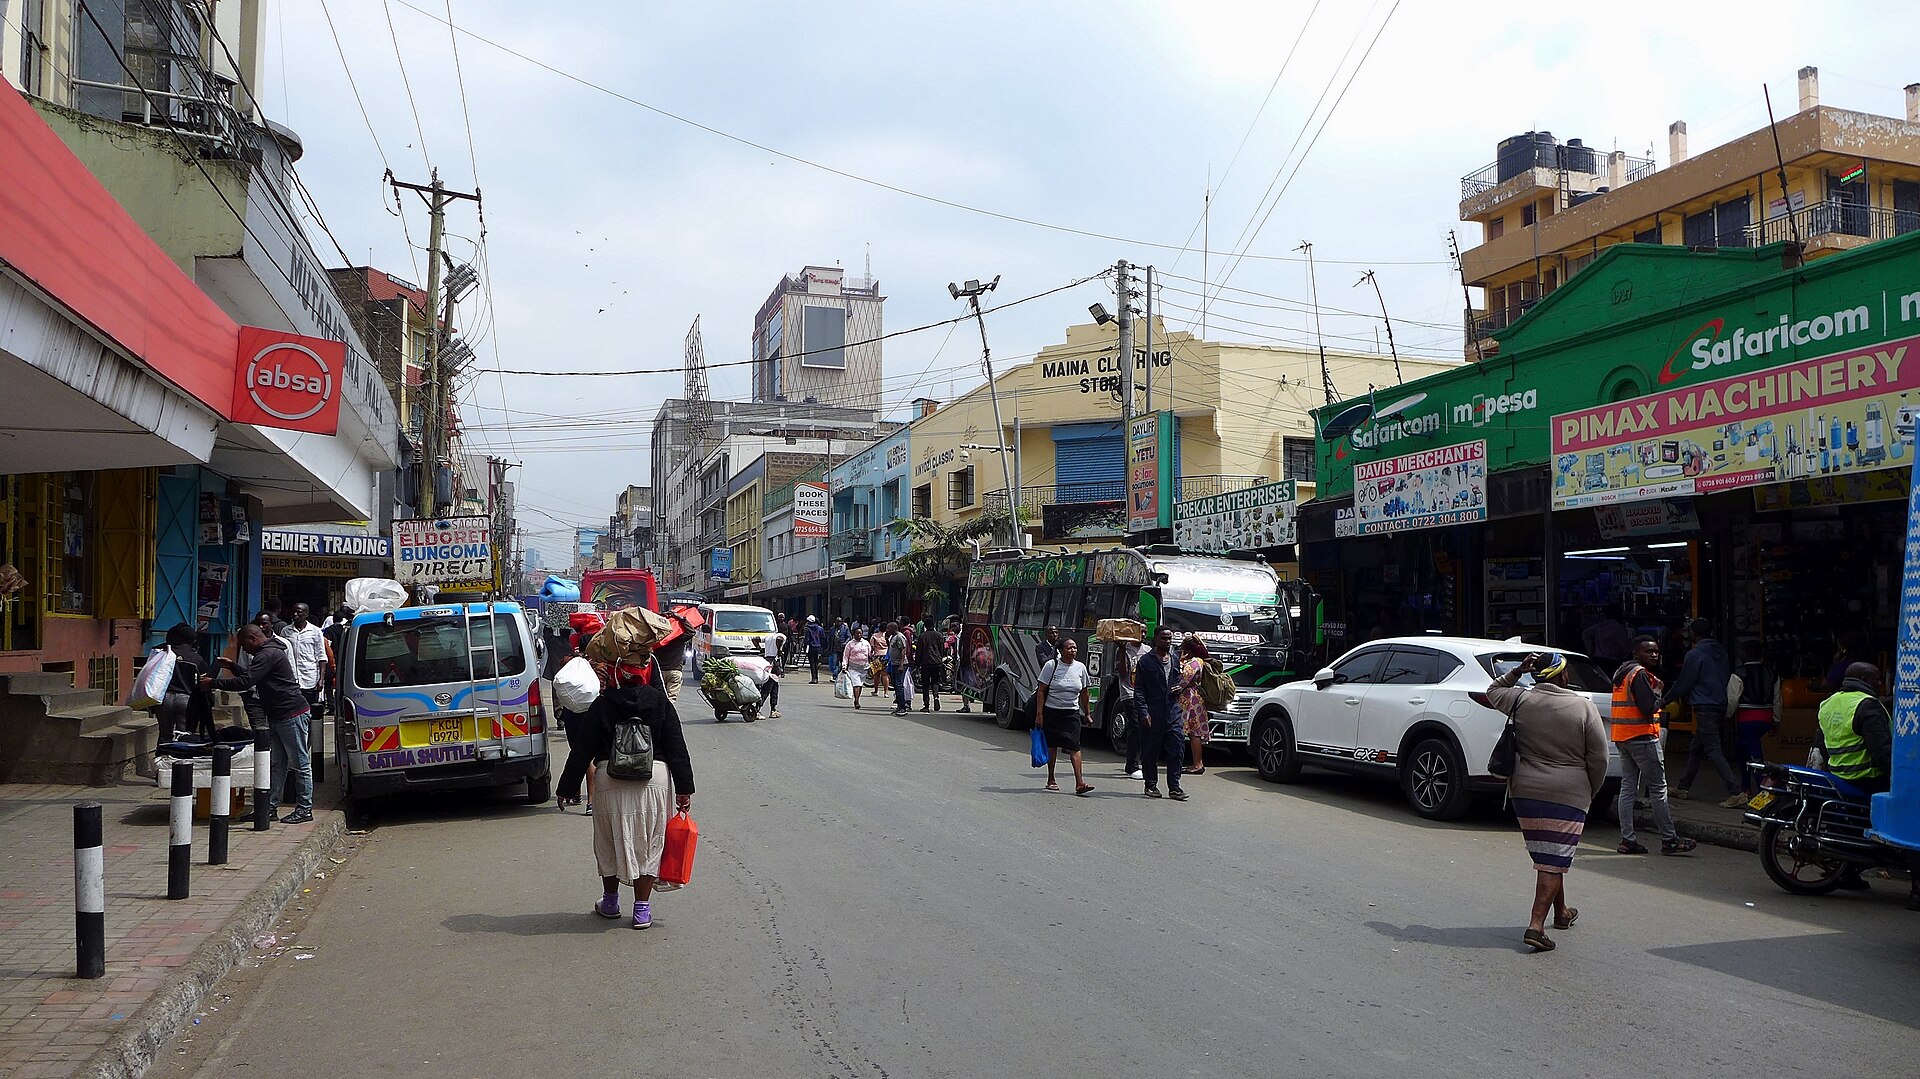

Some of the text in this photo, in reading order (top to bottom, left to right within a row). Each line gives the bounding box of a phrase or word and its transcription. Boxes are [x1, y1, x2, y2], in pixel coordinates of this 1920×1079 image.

[1691, 305, 1869, 370] Safaricom
[1042, 351, 1171, 378] MAINA CLHNG
[257, 364, 322, 394] absa
[1080, 375, 1121, 393] STOR
[365, 371, 383, 425] MALL
[1561, 346, 1909, 446] PIMAX MACHINERY
[1352, 412, 1440, 449] Safaricom
[1358, 442, 1483, 479] DAVIS MERCHANTS
[1177, 498, 1215, 519] PREKAR
[1217, 482, 1290, 513] ENTERPRISES
[795, 509, 828, 517] SPACES
[1625, 507, 1662, 518] APPROVED
[397, 520, 435, 533] SATIMA
[1364, 510, 1479, 534] CONTACT: 0722 304 800
[1630, 517, 1662, 528] STOCKIST
[323, 535, 387, 556] TRADING
[399, 529, 488, 547] ELDORET
[401, 544, 489, 562] BUNGOMA
[292, 559, 328, 568] TRADING
[330, 561, 341, 569] CO
[343, 561, 357, 570] LTD
[412, 559, 487, 577] DIRECT
[1192, 589, 1281, 605] SPEED
[422, 609, 451, 617] STOP
[438, 719, 459, 730] KCU
[417, 744, 476, 765] SHUTTLE
[1354, 748, 1388, 763] CX-5
